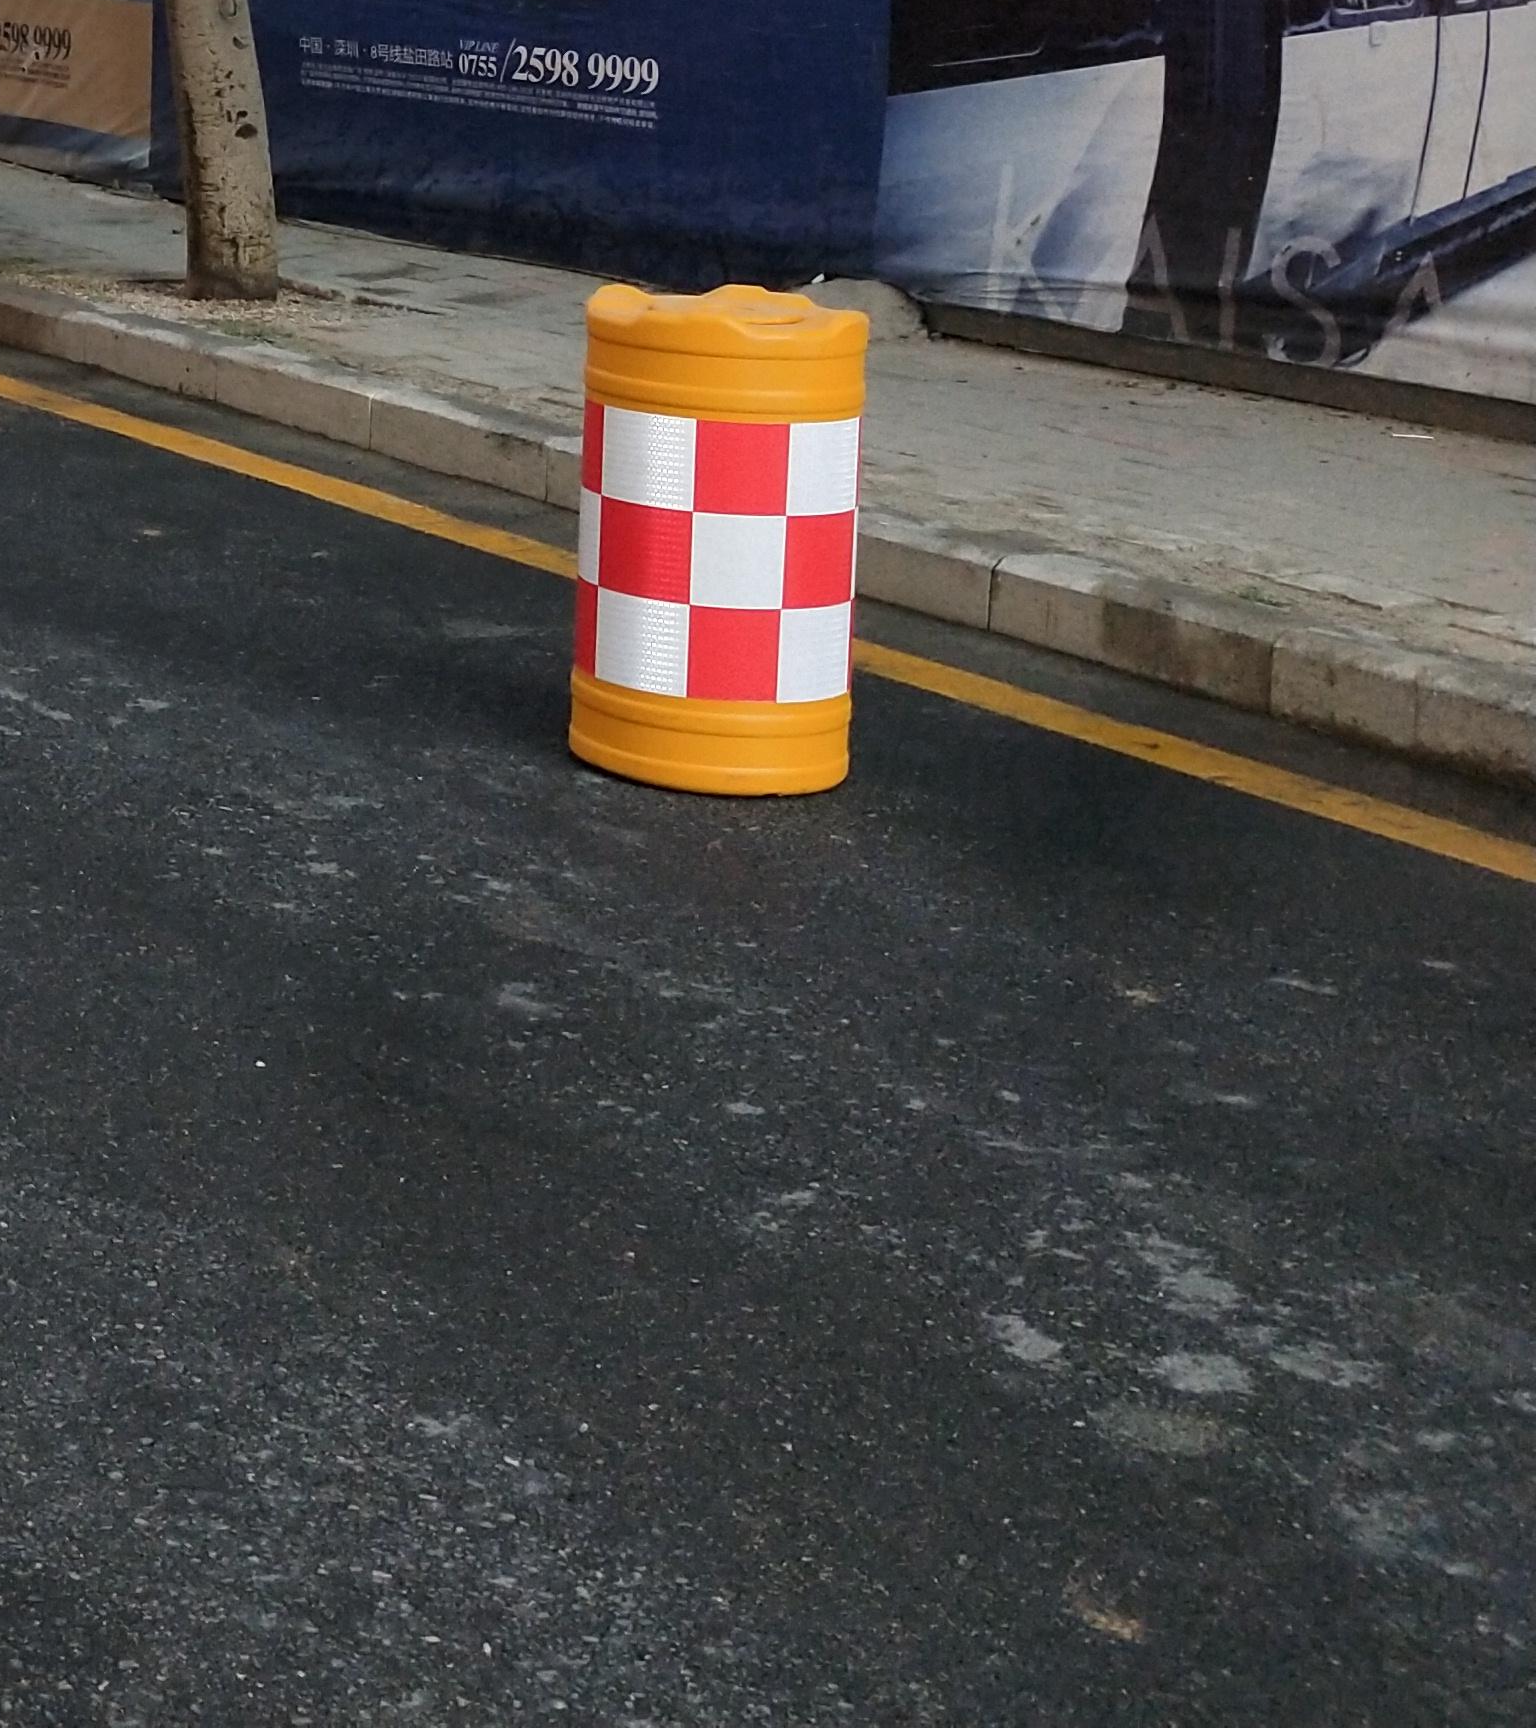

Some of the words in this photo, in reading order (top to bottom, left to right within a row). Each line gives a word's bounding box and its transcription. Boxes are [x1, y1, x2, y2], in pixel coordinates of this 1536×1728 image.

[458, 53, 497, 79] 0755
[512, 45, 579, 87] 2598
[587, 52, 659, 96] 9999
